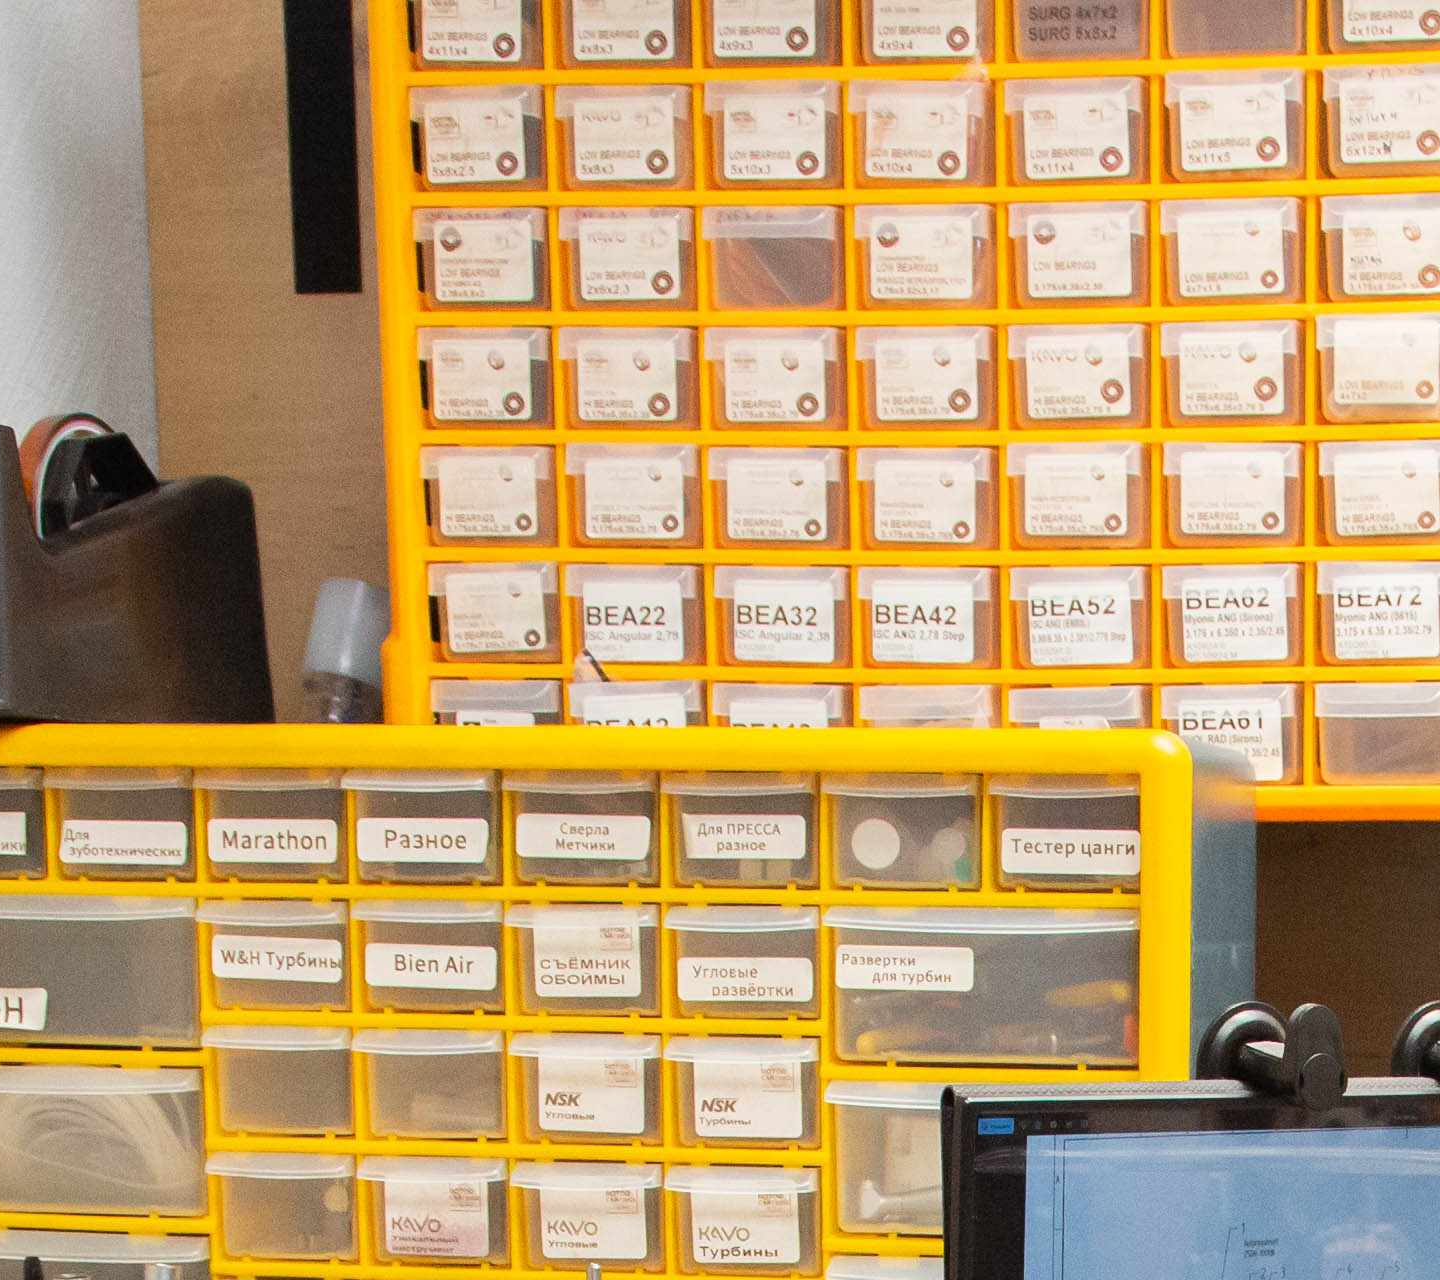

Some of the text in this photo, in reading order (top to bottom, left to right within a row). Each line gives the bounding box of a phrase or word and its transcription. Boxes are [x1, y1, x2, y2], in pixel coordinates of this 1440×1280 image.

[585, 606, 665, 626] BEA22
[736, 604, 817, 626] BEA32
[875, 604, 956, 625] BEA42
[64, 827, 89, 844] Для
[559, 821, 610, 837] Сверла
[697, 822, 781, 837] Для ПРЕССА
[222, 829, 326, 850] Marathon
[384, 829, 467, 849] Разное
[555, 838, 615, 851] Метчики
[716, 841, 766, 853] разное
[1010, 838, 1135, 858] Тестер цанги
[220, 949, 342, 971] W&H Турбины
[394, 953, 474, 973] Bien Air
[871, 969, 951, 985] для турбин
[544, 1091, 580, 1106] NSK
[701, 1097, 736, 1112] NSK
[699, 1116, 751, 1126] Турбины
[391, 1217, 441, 1234] KAVO
[547, 1219, 598, 1236] KAVO
[698, 1225, 750, 1242] KAVO
[699, 1245, 778, 1259] Турбины
